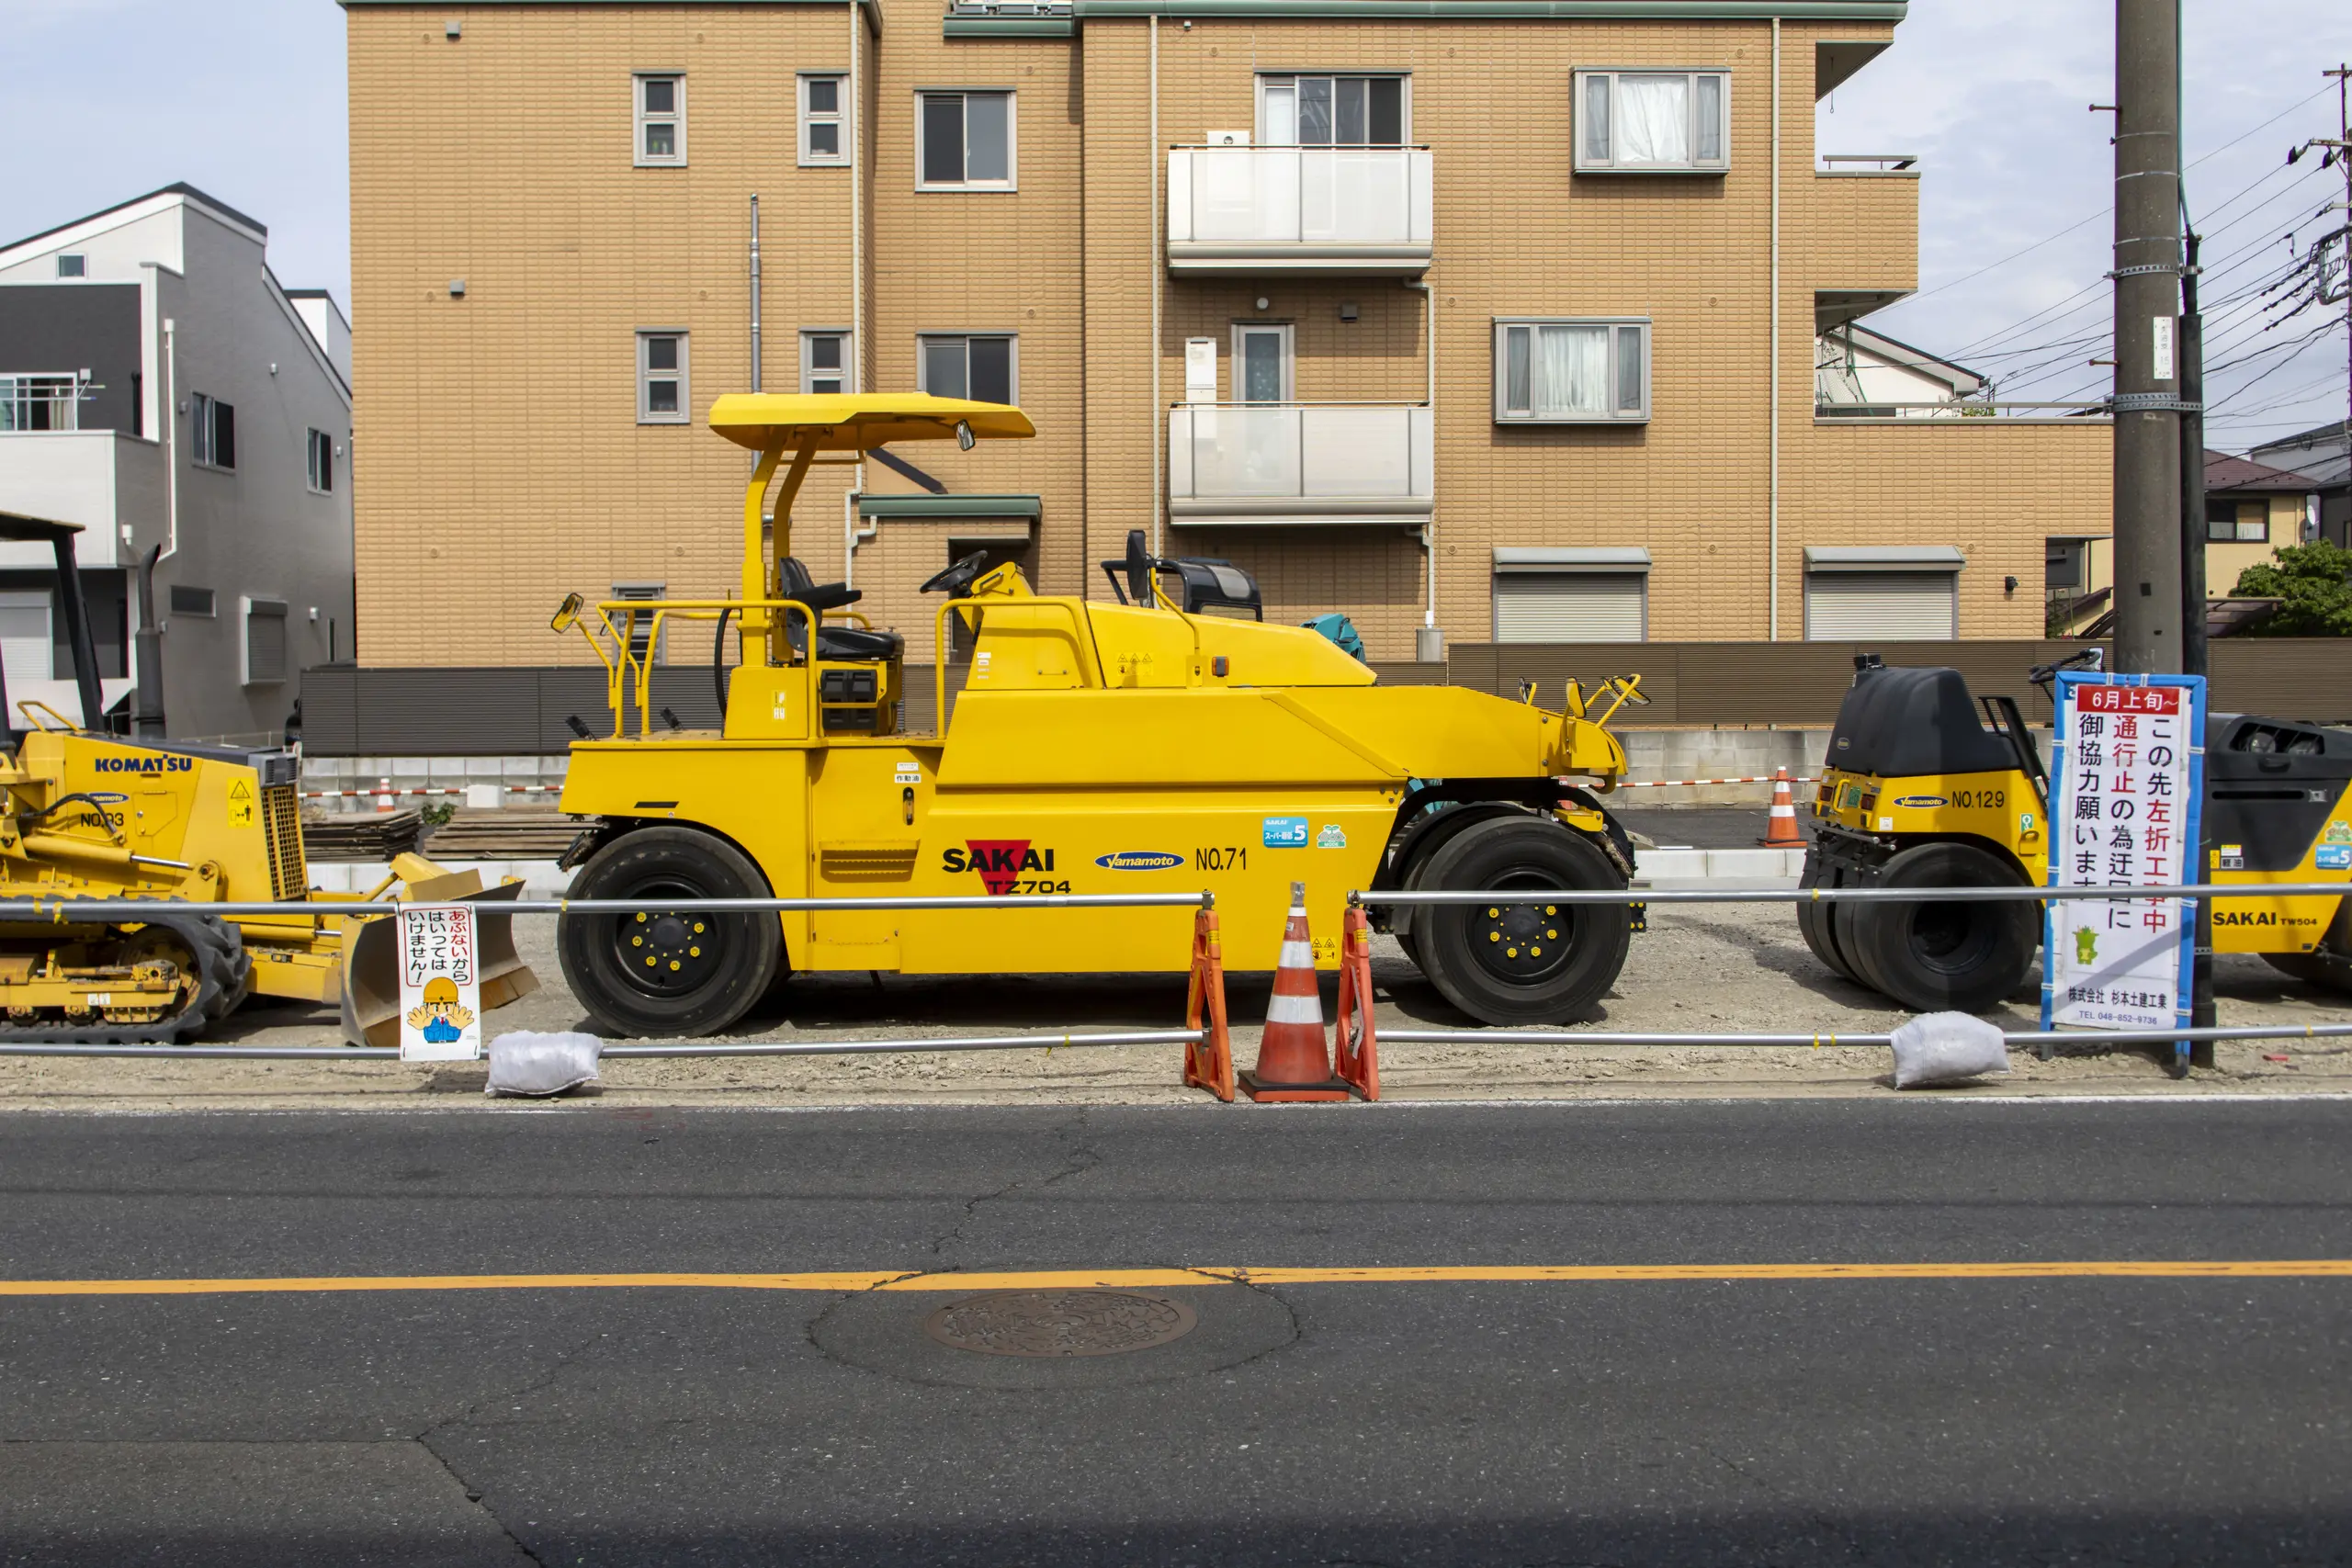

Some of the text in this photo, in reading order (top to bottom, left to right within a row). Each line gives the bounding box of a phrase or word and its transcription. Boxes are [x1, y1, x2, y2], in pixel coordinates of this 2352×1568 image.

[95, 754, 192, 772] KOMATSU
[1900, 791, 2005, 808] Yamamoto NO.129
[942, 848, 1055, 873] SAKAI
[1105, 848, 1247, 870] Yamamoto NO.71
[988, 880, 1071, 895] TZ704
[2212, 912, 2317, 926] SAKAI TW504
[408, 911, 427, 984] いけません!
[429, 911, 447, 971] はいっては
[448, 910, 469, 982] あぶないから
[2067, 986, 2167, 1010] 株式会社 杉本土建工業
[2079, 1010, 2095, 1020] TEL
